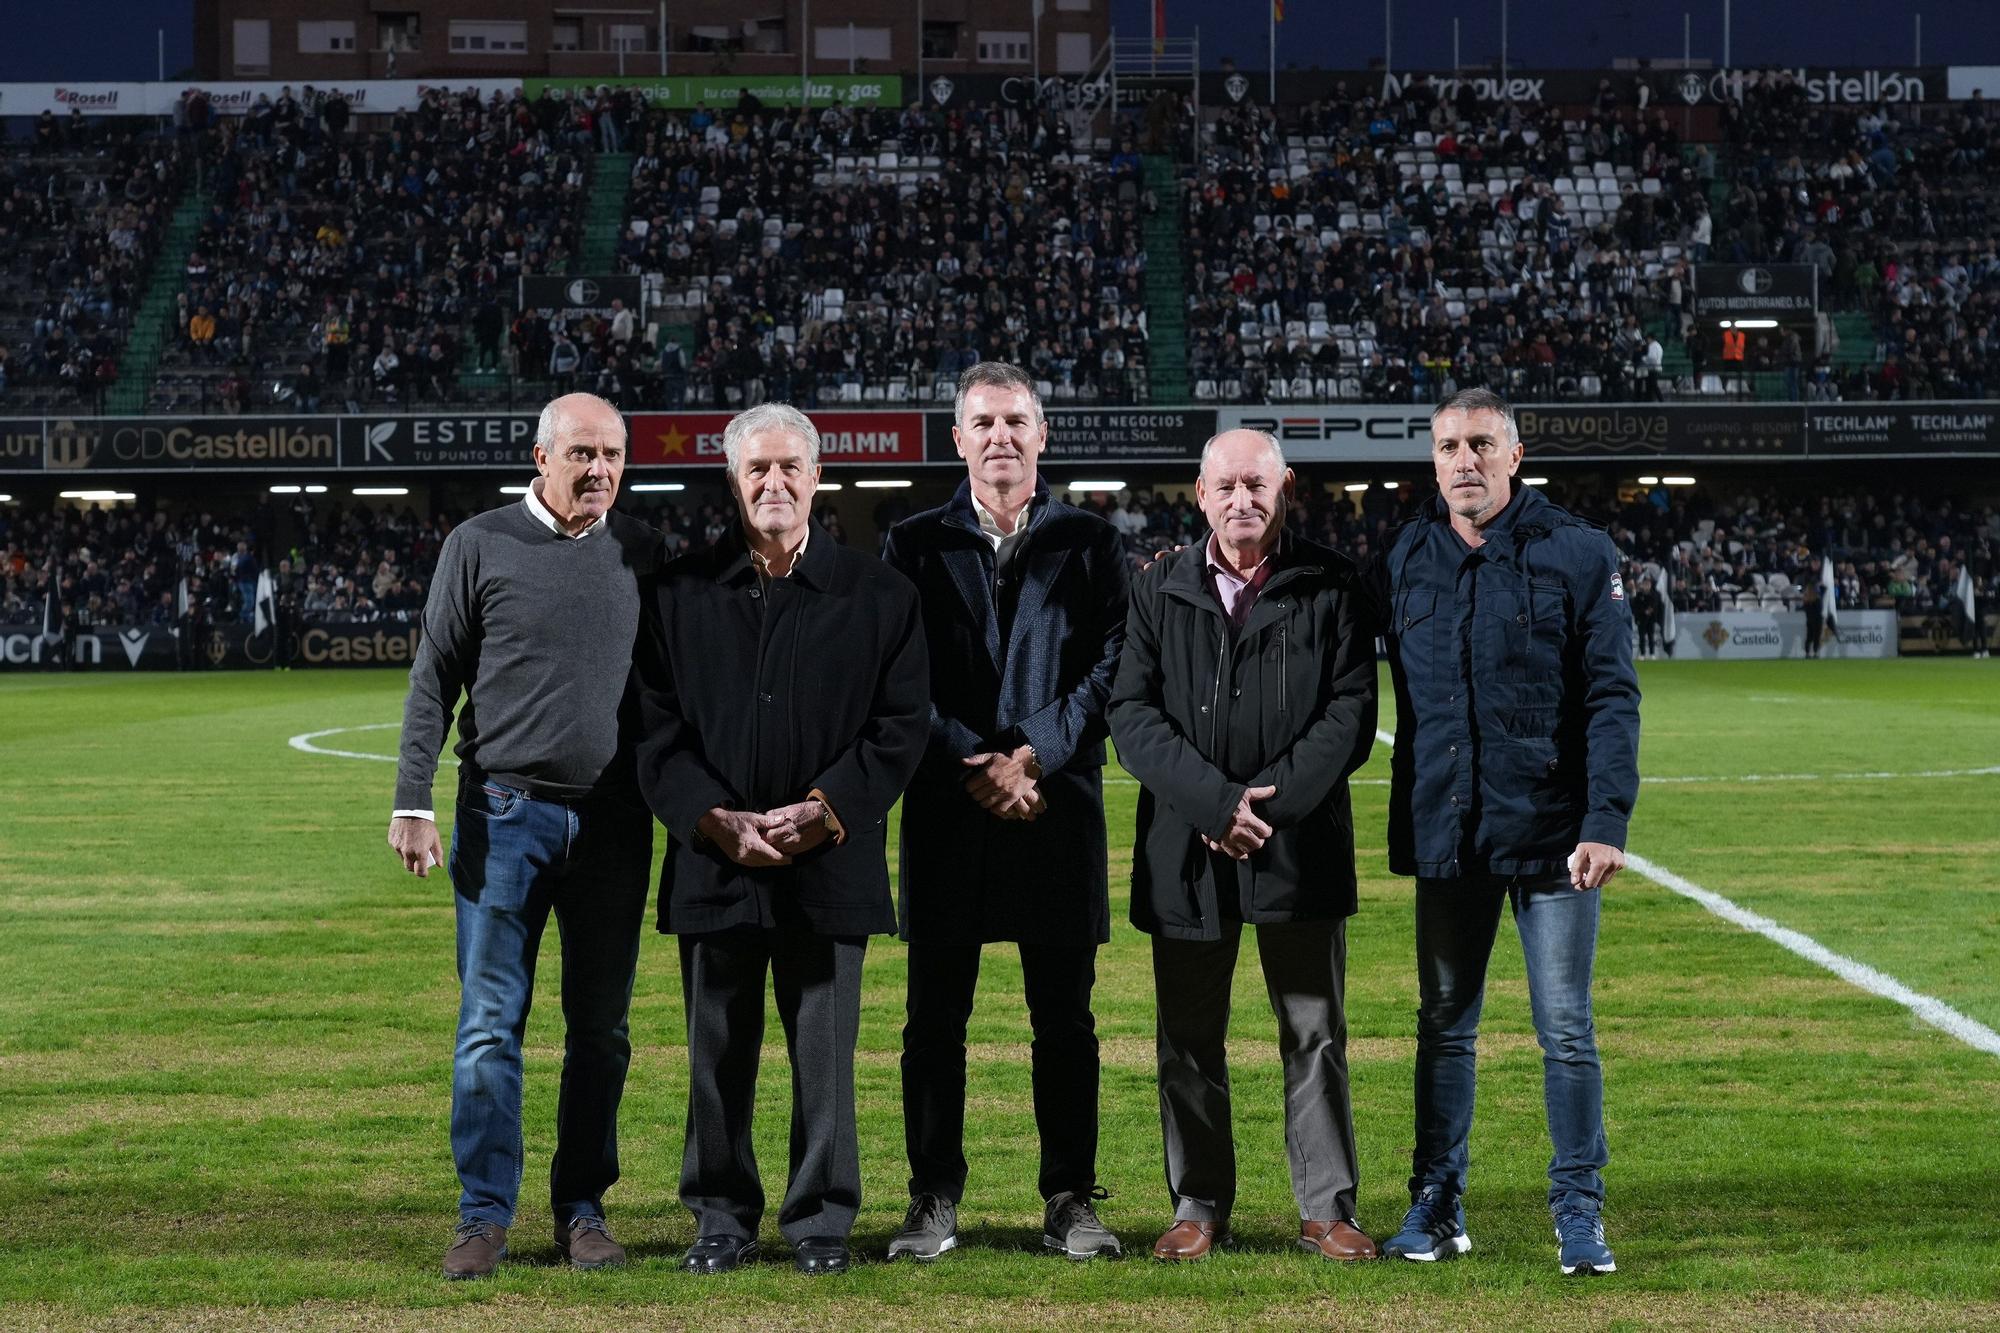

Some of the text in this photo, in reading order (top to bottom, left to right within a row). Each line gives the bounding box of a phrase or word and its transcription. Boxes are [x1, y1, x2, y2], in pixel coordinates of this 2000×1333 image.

[68, 91, 118, 104] Rosell
[720, 84, 784, 99] copañía
[804, 80, 833, 99] luz
[847, 84, 882, 102] gas
[413, 420, 537, 444] ESTEP
[1083, 415, 1102, 428] DE
[1109, 415, 1185, 428] NEGOCIOS
[1520, 411, 1668, 441] Bravoplaya
[0, 434, 40, 457] UT
[822, 432, 899, 457] DAMM
[1832, 432, 1889, 444] LEVANTINA
[1930, 432, 1987, 442] LEVANTINA
[414, 451, 432, 462] TU
[438, 450, 488, 462] PUNTO
[494, 450, 512, 462] DE
[0, 634, 101, 664] crn
